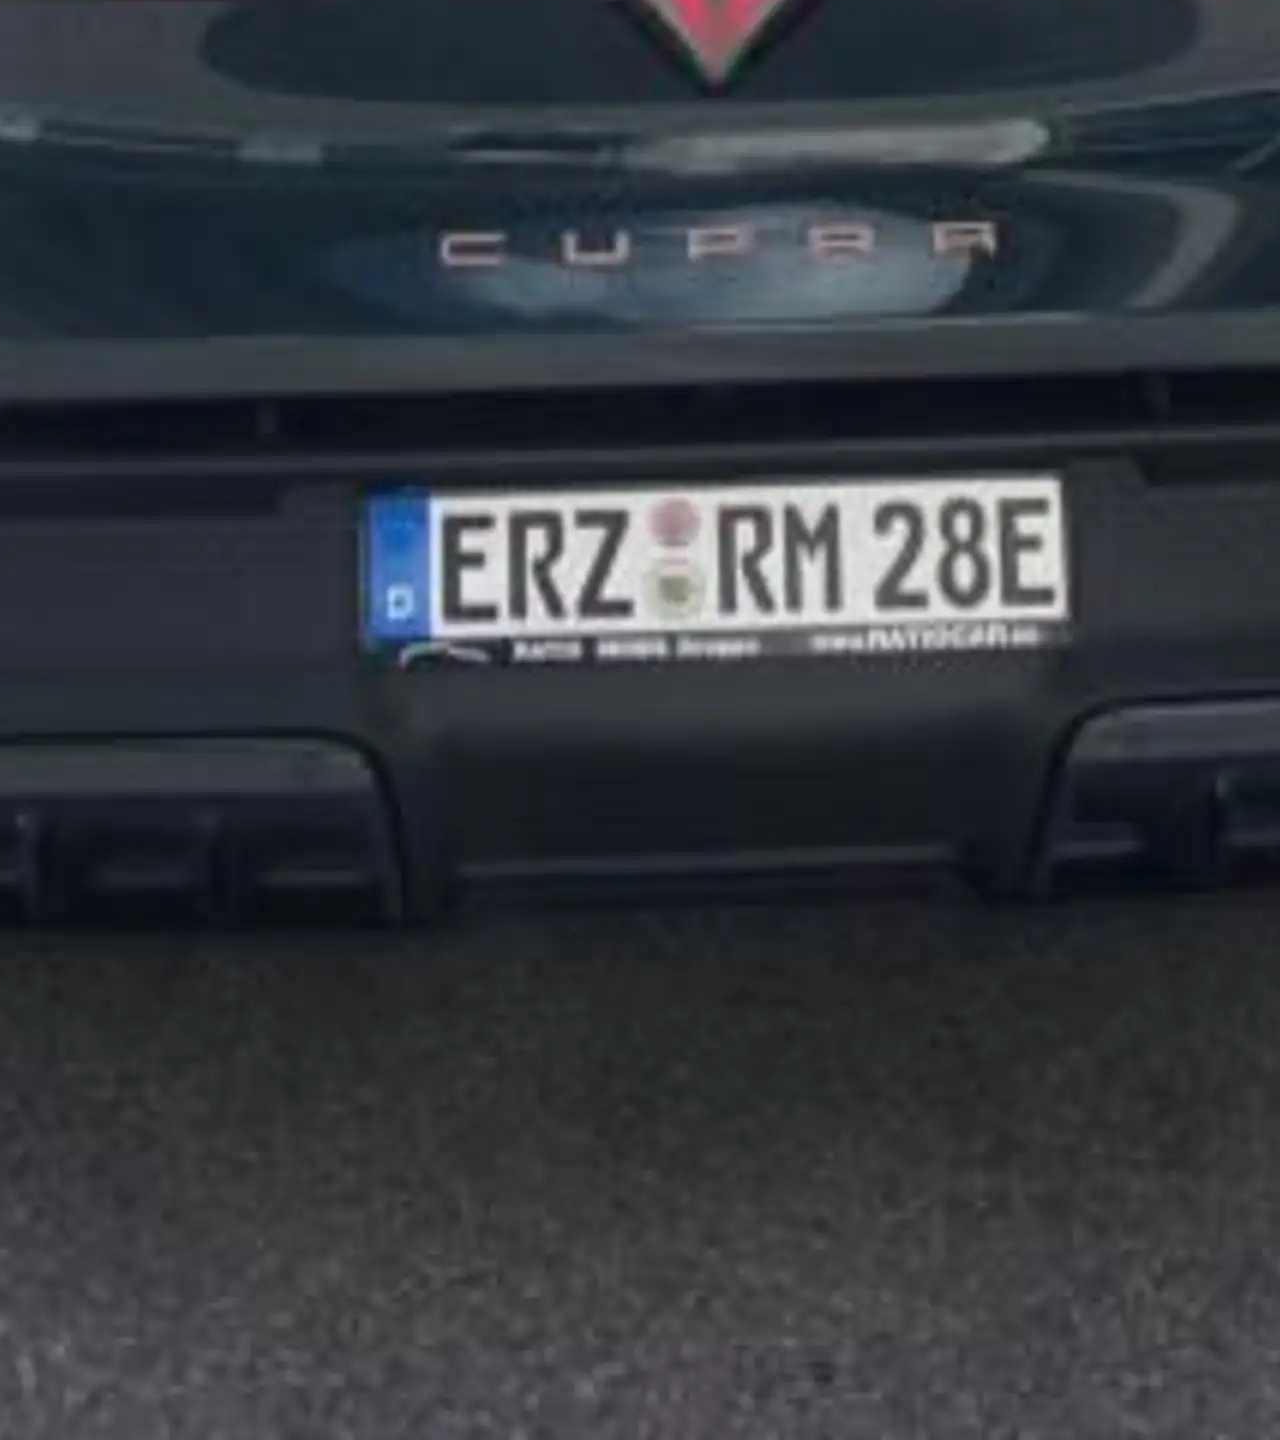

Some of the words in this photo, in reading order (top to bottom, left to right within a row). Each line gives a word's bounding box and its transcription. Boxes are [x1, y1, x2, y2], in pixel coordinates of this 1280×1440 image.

[440, 219, 996, 266] CUPRA
[440, 508, 634, 623] ERZ
[718, 502, 842, 614] RM
[873, 497, 1056, 611] 28E
